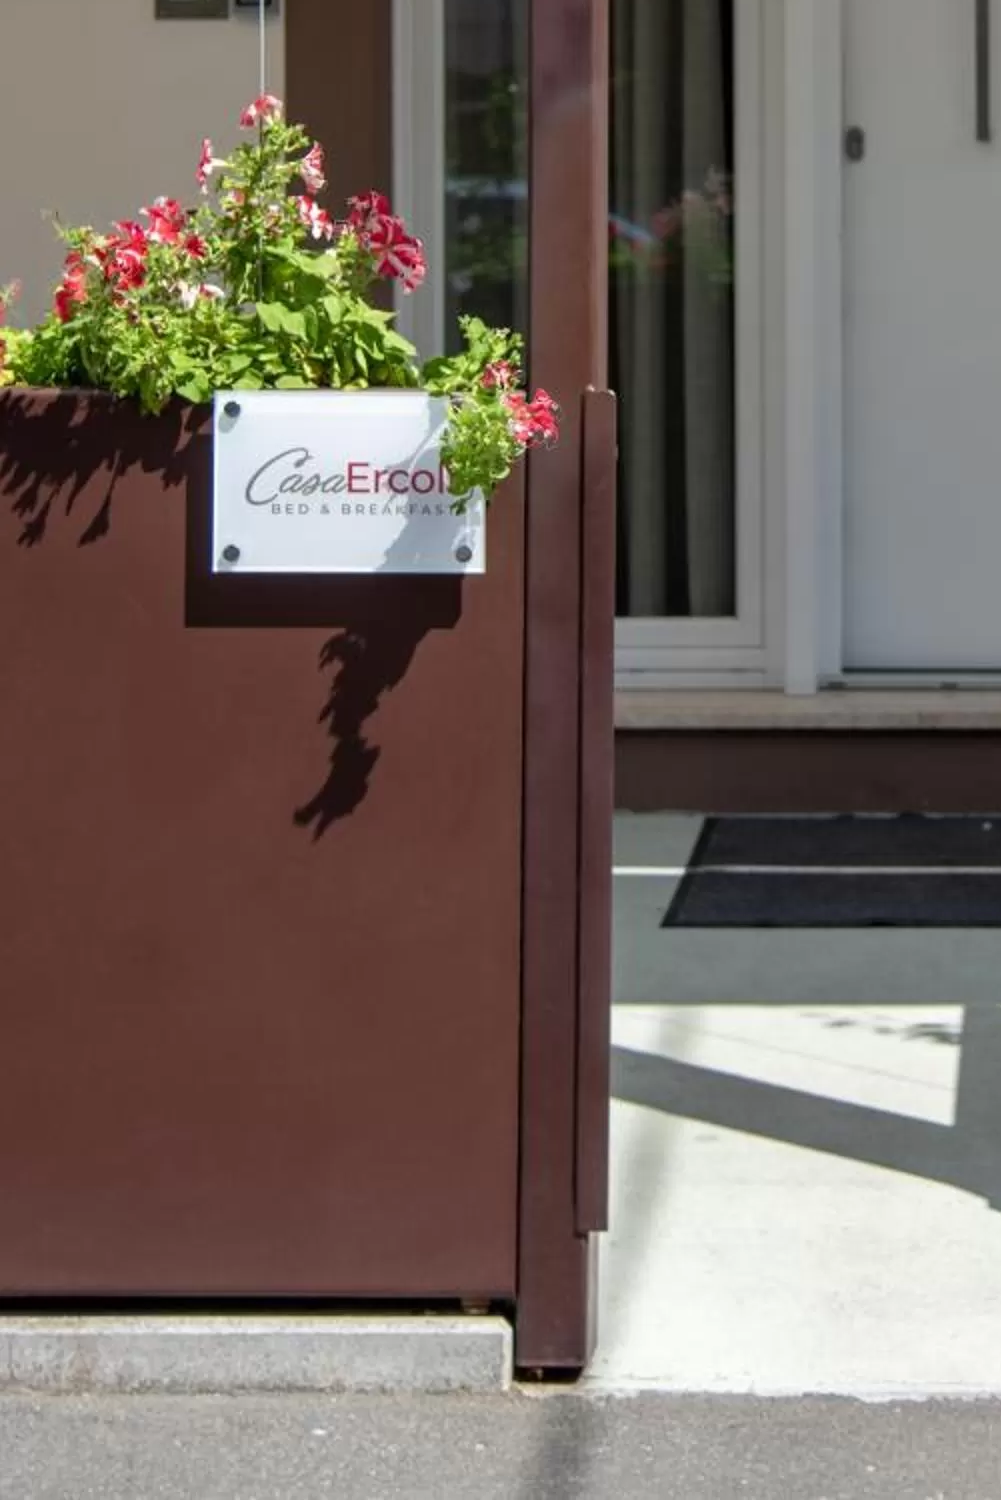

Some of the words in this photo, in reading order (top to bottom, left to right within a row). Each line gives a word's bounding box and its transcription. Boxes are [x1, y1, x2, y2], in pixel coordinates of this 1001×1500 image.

[244, 447, 448, 506] CasaErcol
[271, 503, 313, 515] BED
[320, 503, 331, 515] &
